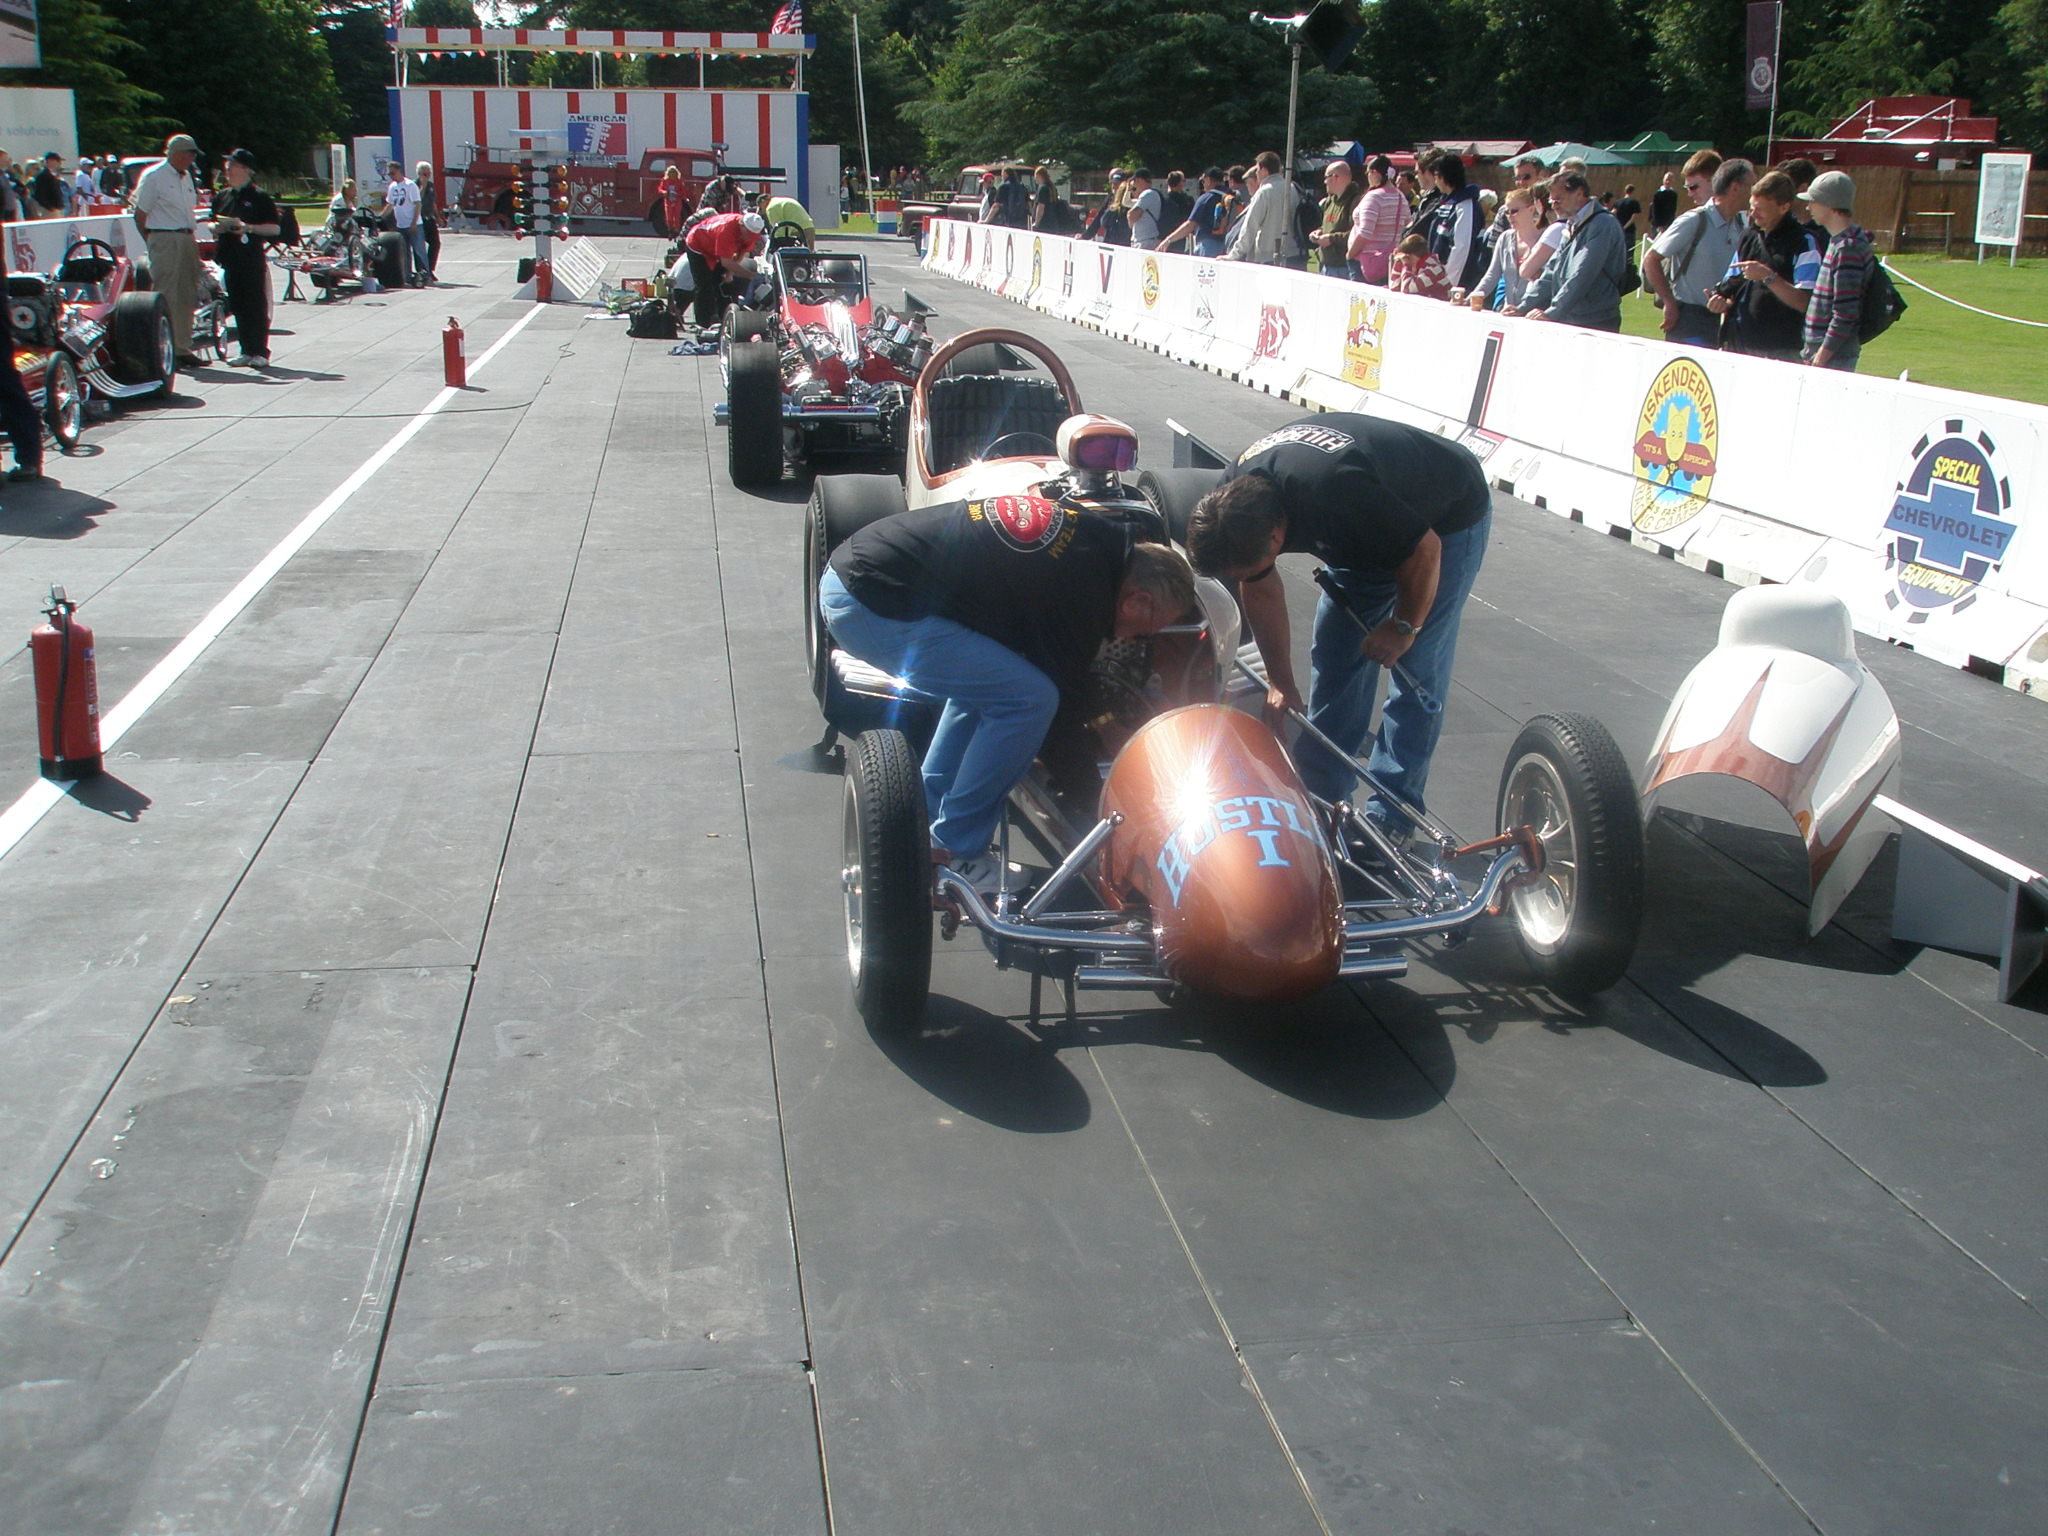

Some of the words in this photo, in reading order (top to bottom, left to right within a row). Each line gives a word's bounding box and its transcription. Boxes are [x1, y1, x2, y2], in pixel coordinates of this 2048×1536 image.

[1643, 366, 1716, 440] ISKENDERIAN
[1931, 456, 1982, 486] SPECIAL
[1892, 504, 2009, 550] CHEVROLET
[1899, 563, 1974, 599] EQUIPMENT
